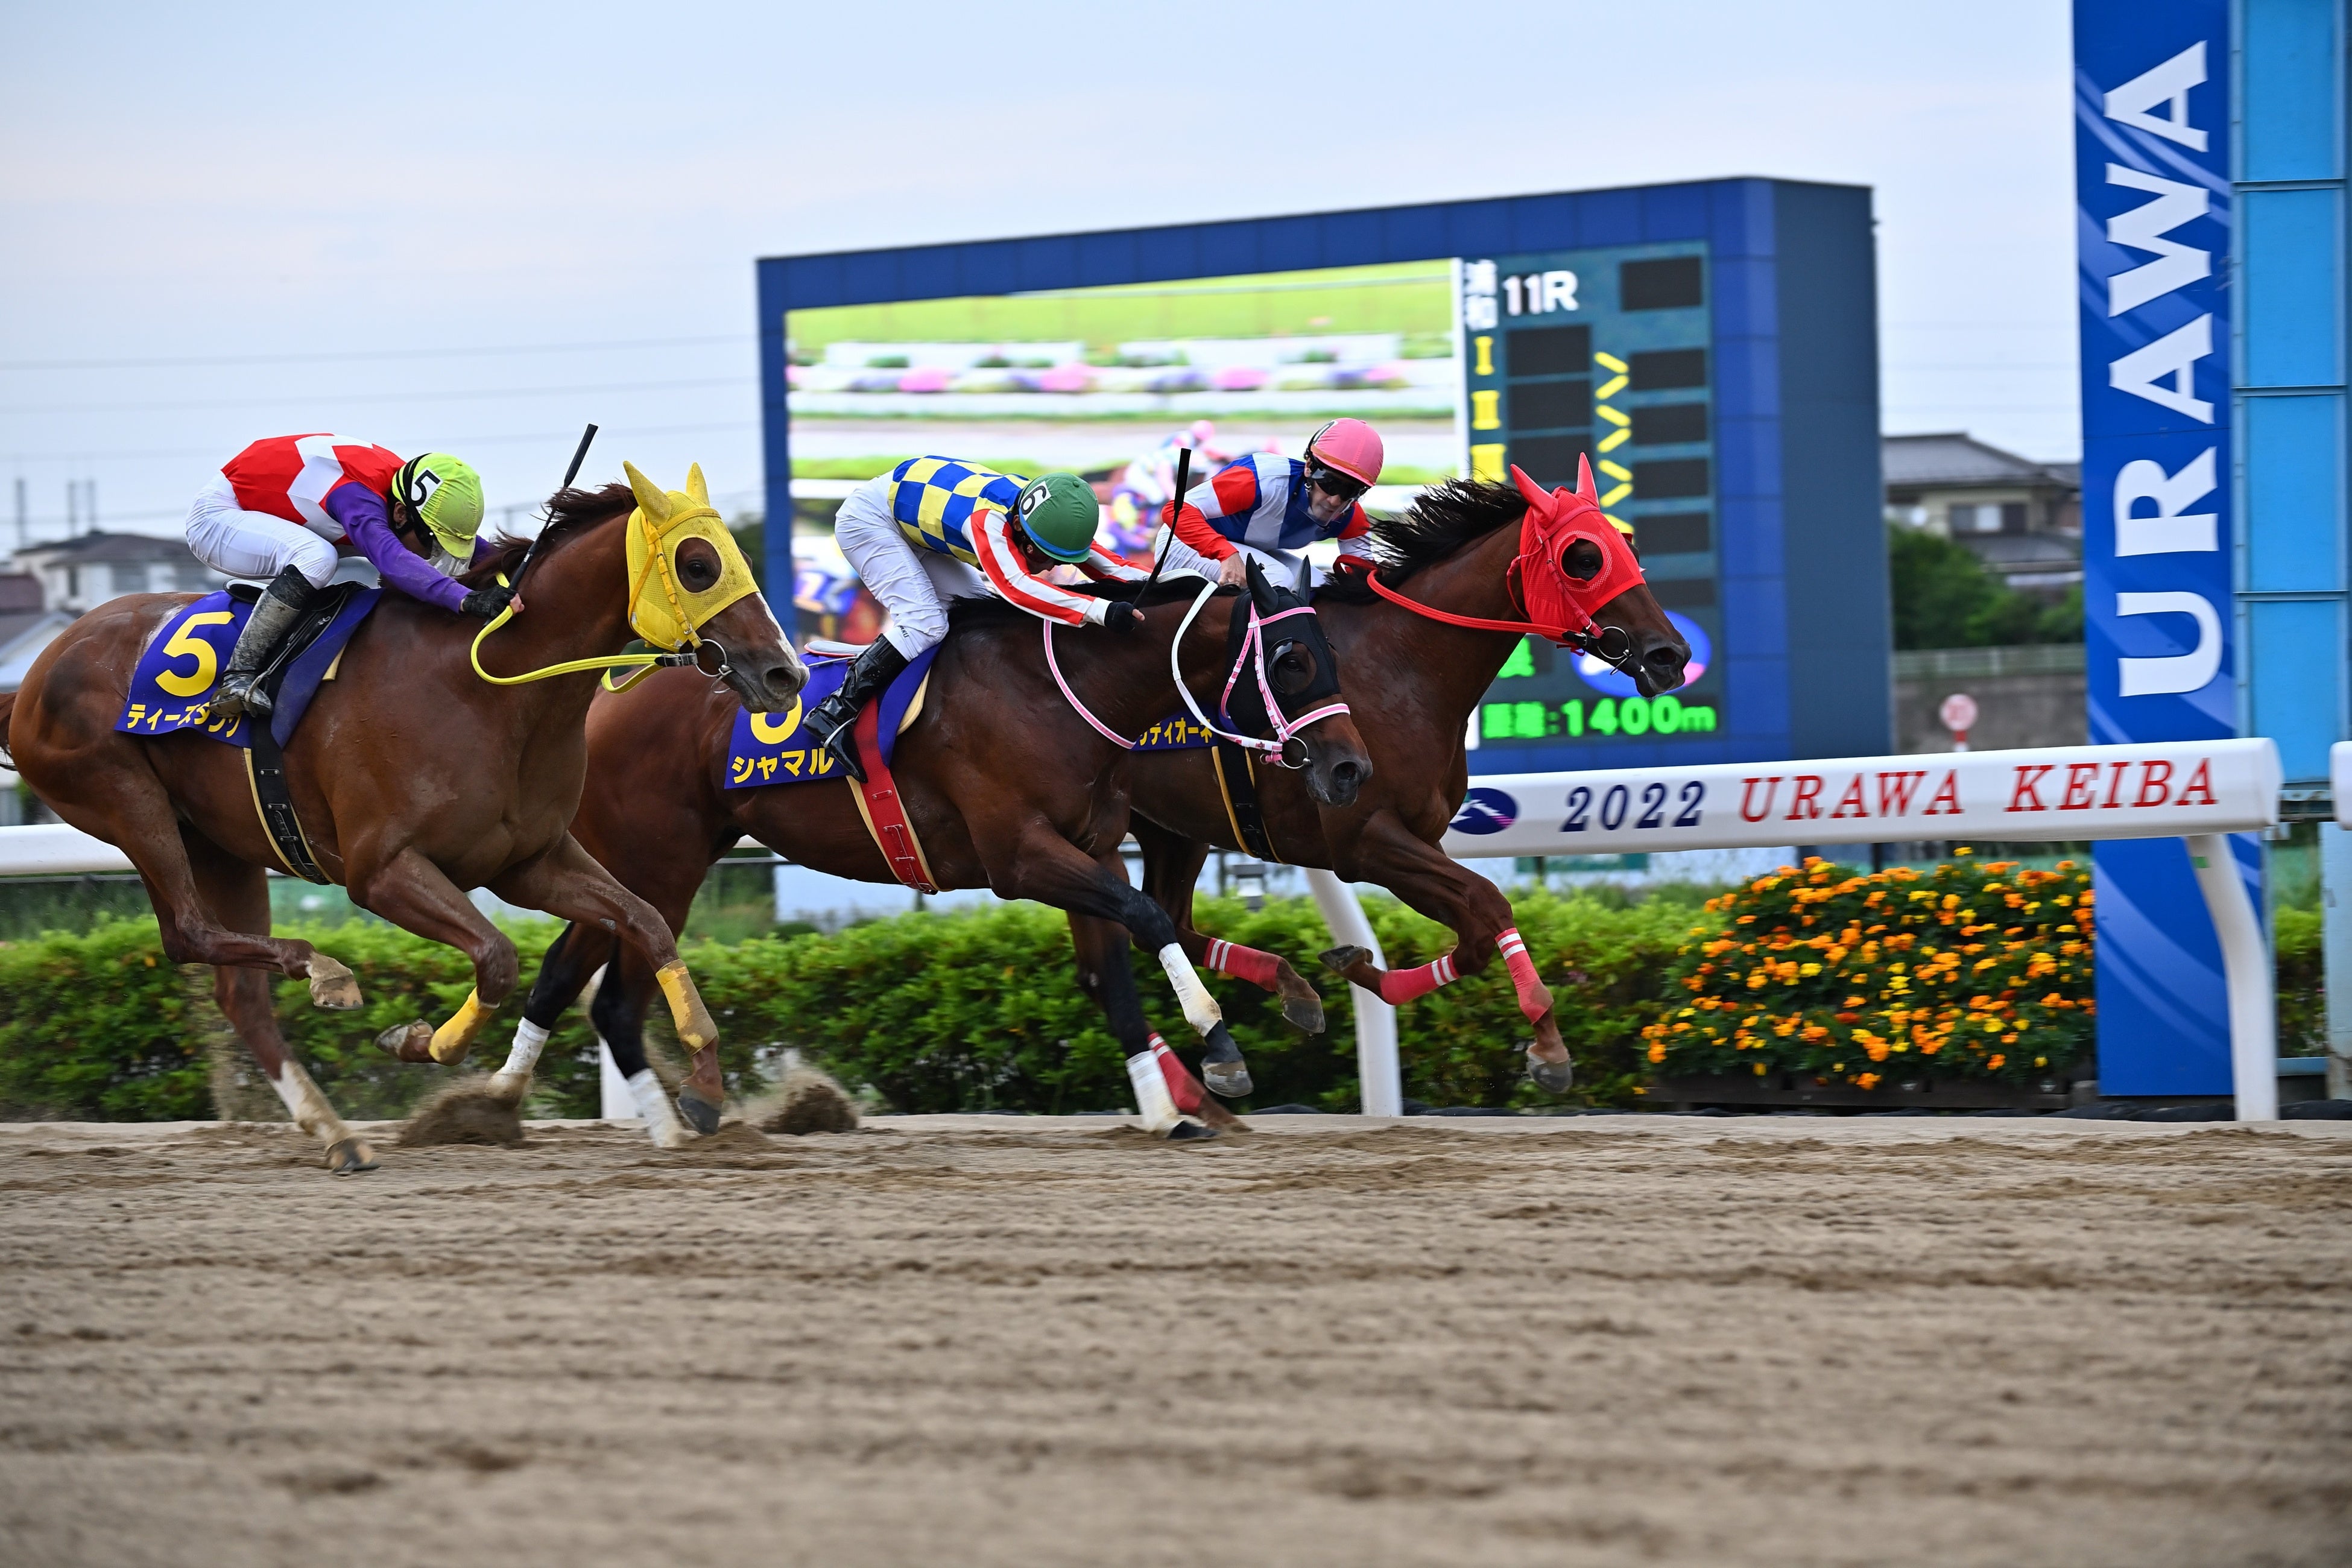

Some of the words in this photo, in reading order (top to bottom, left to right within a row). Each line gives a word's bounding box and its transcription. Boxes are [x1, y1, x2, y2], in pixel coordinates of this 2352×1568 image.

[1503, 270, 1579, 317] 11R
[2103, 39, 2224, 698] URAWA
[409, 469, 441, 507] 5
[1021, 485, 1047, 515] 6
[155, 611, 235, 697] 5
[732, 748, 835, 784] シャマル
[1560, 781, 1706, 832] 2022
[1739, 771, 1964, 822] URAWA
[2004, 757, 2218, 812] KEIBA
